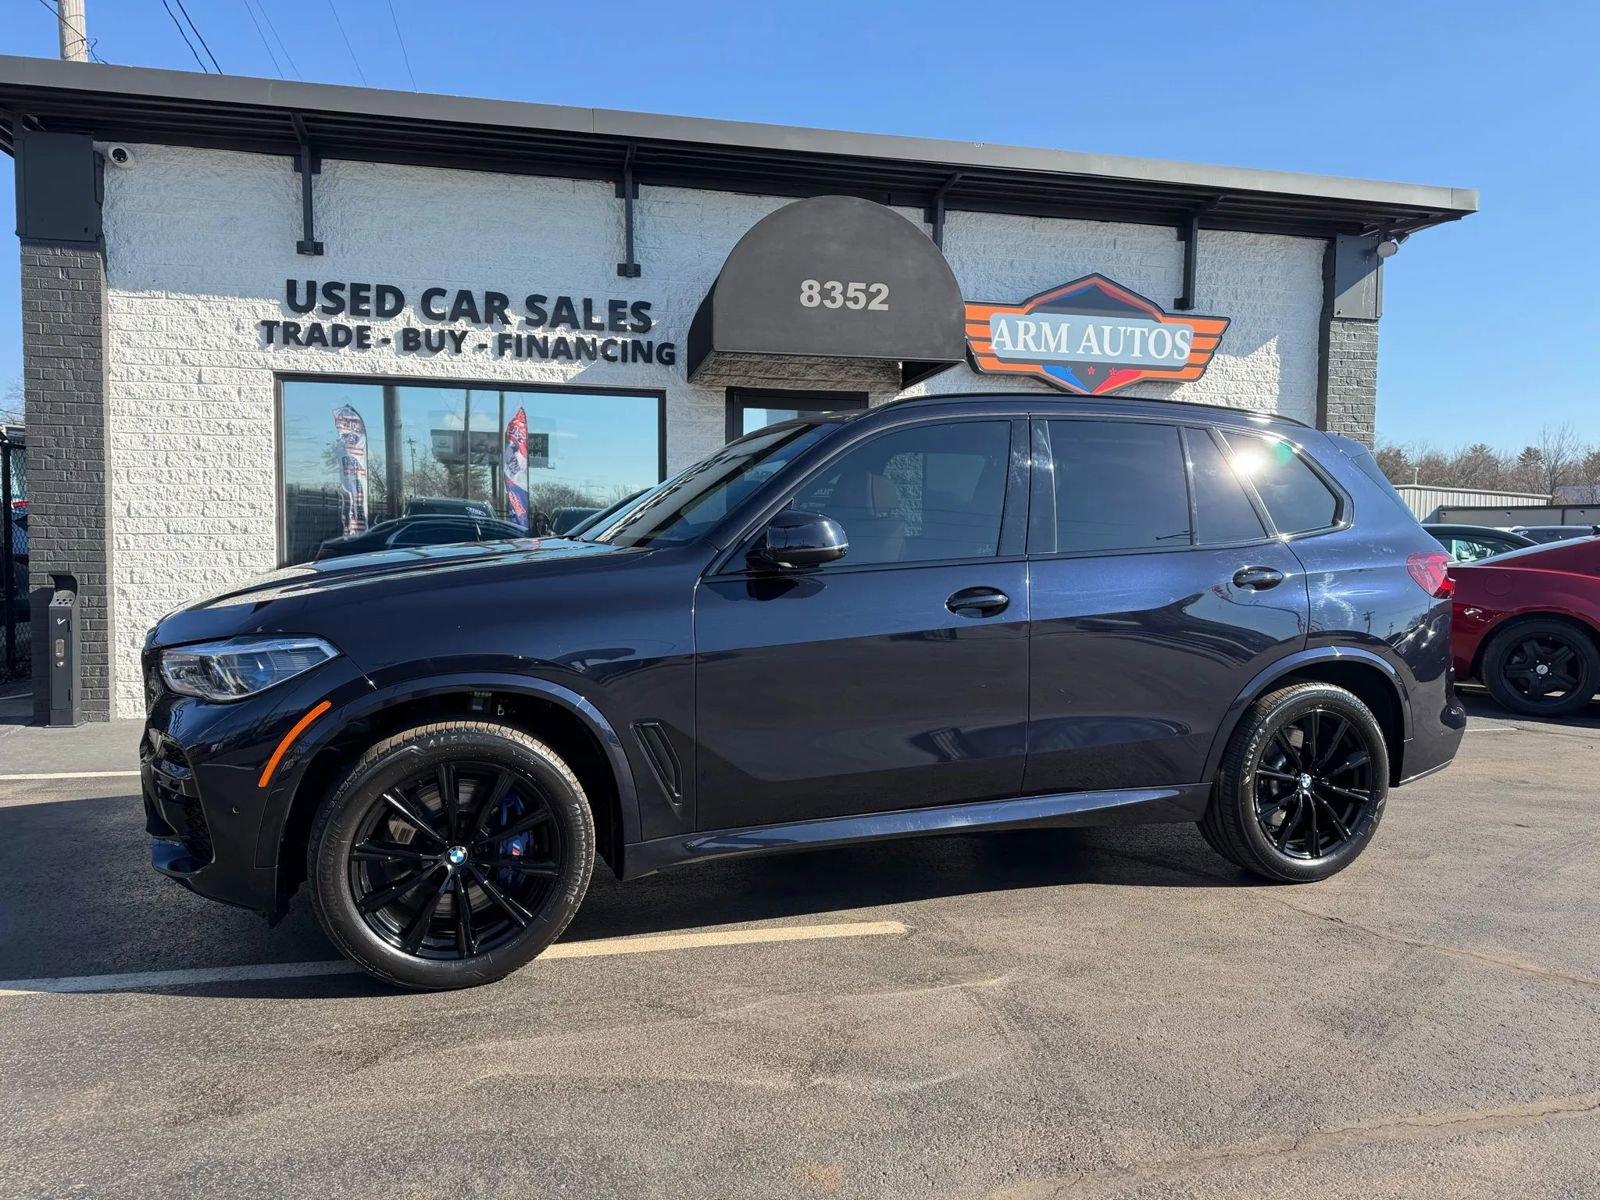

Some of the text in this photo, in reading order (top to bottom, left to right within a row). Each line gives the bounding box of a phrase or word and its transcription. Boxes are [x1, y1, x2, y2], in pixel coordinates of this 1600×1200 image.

[286, 279, 653, 334] USED CAR SALES
[799, 279, 890, 311] 8352
[261, 320, 372, 349] TRADE
[402, 327, 467, 354] BUY
[498, 336, 676, 366] FINANCING
[988, 318, 1192, 361] ARM AUTOS
